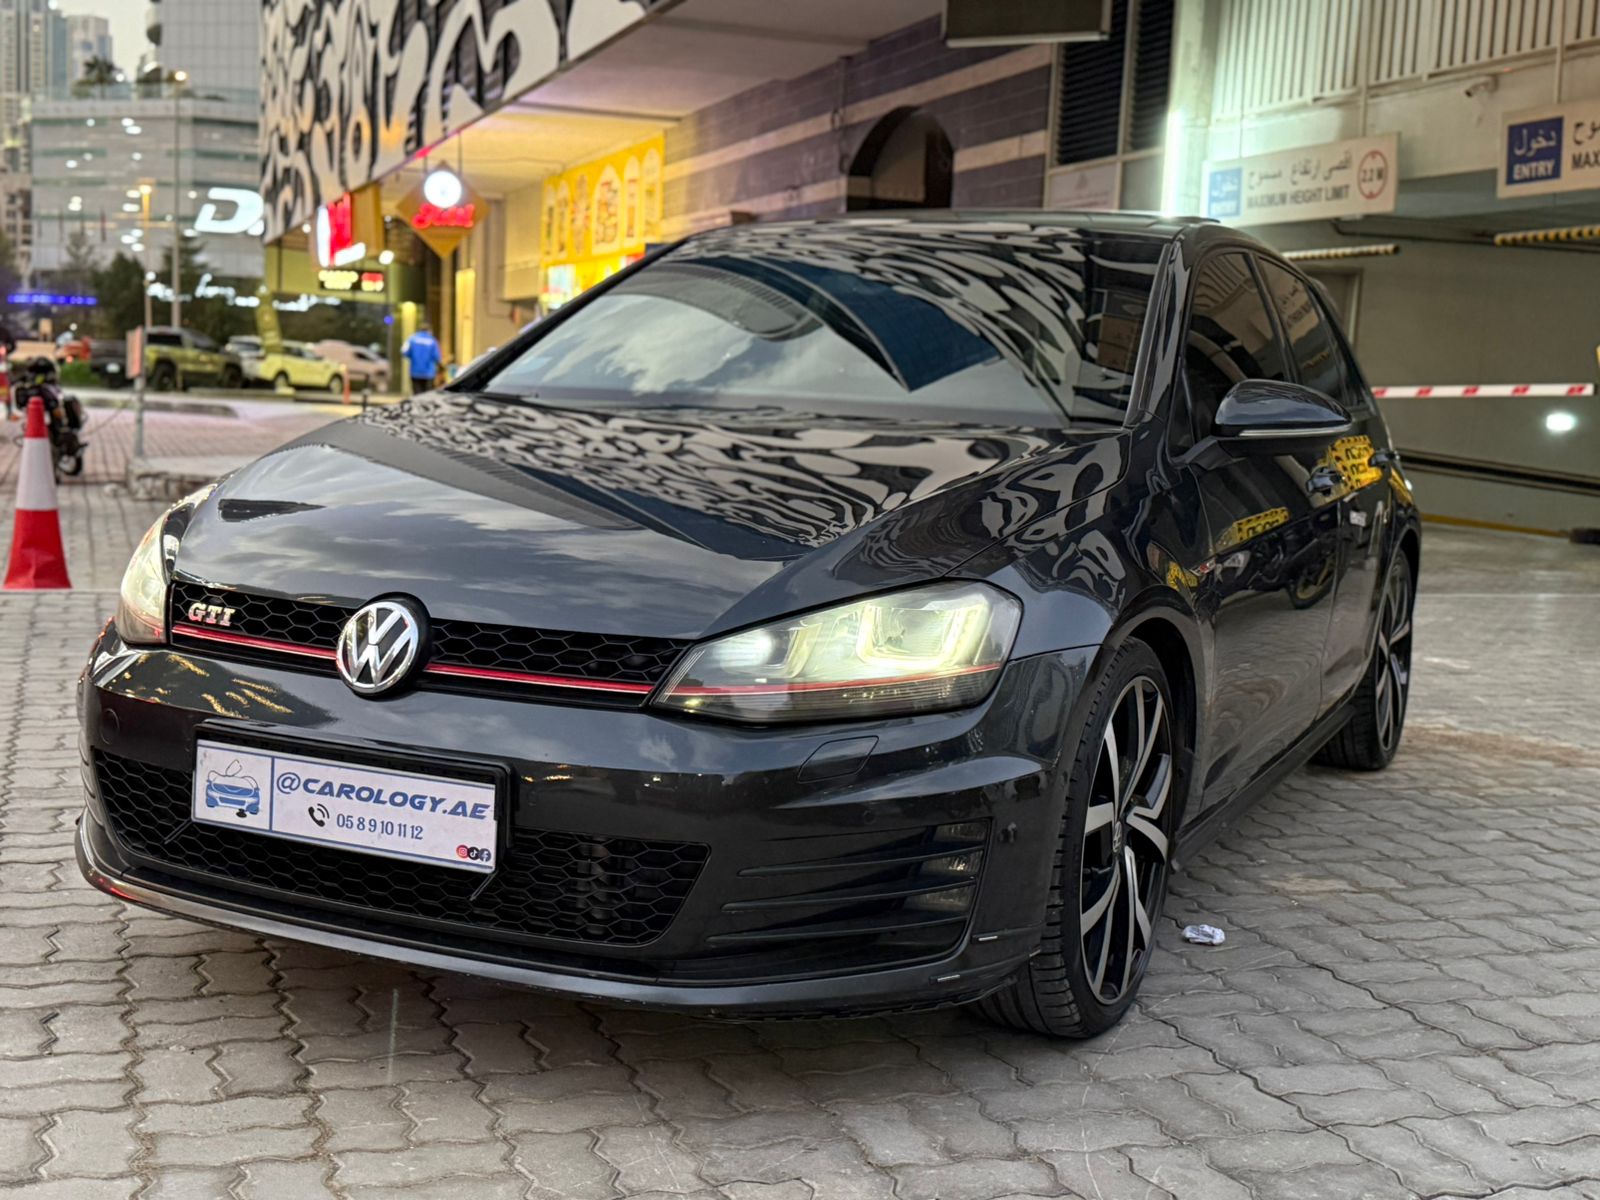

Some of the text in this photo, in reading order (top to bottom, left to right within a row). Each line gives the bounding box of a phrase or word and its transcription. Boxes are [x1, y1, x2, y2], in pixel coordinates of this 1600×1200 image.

[1513, 127, 1557, 158] دخول
[1513, 158, 1556, 181] ENTRY
[1290, 186, 1324, 205] HEIGHT
[1325, 184, 1350, 201] LIMIT
[187, 602, 236, 627] GTI
[276, 772, 490, 820] @CAROLOGY.AE
